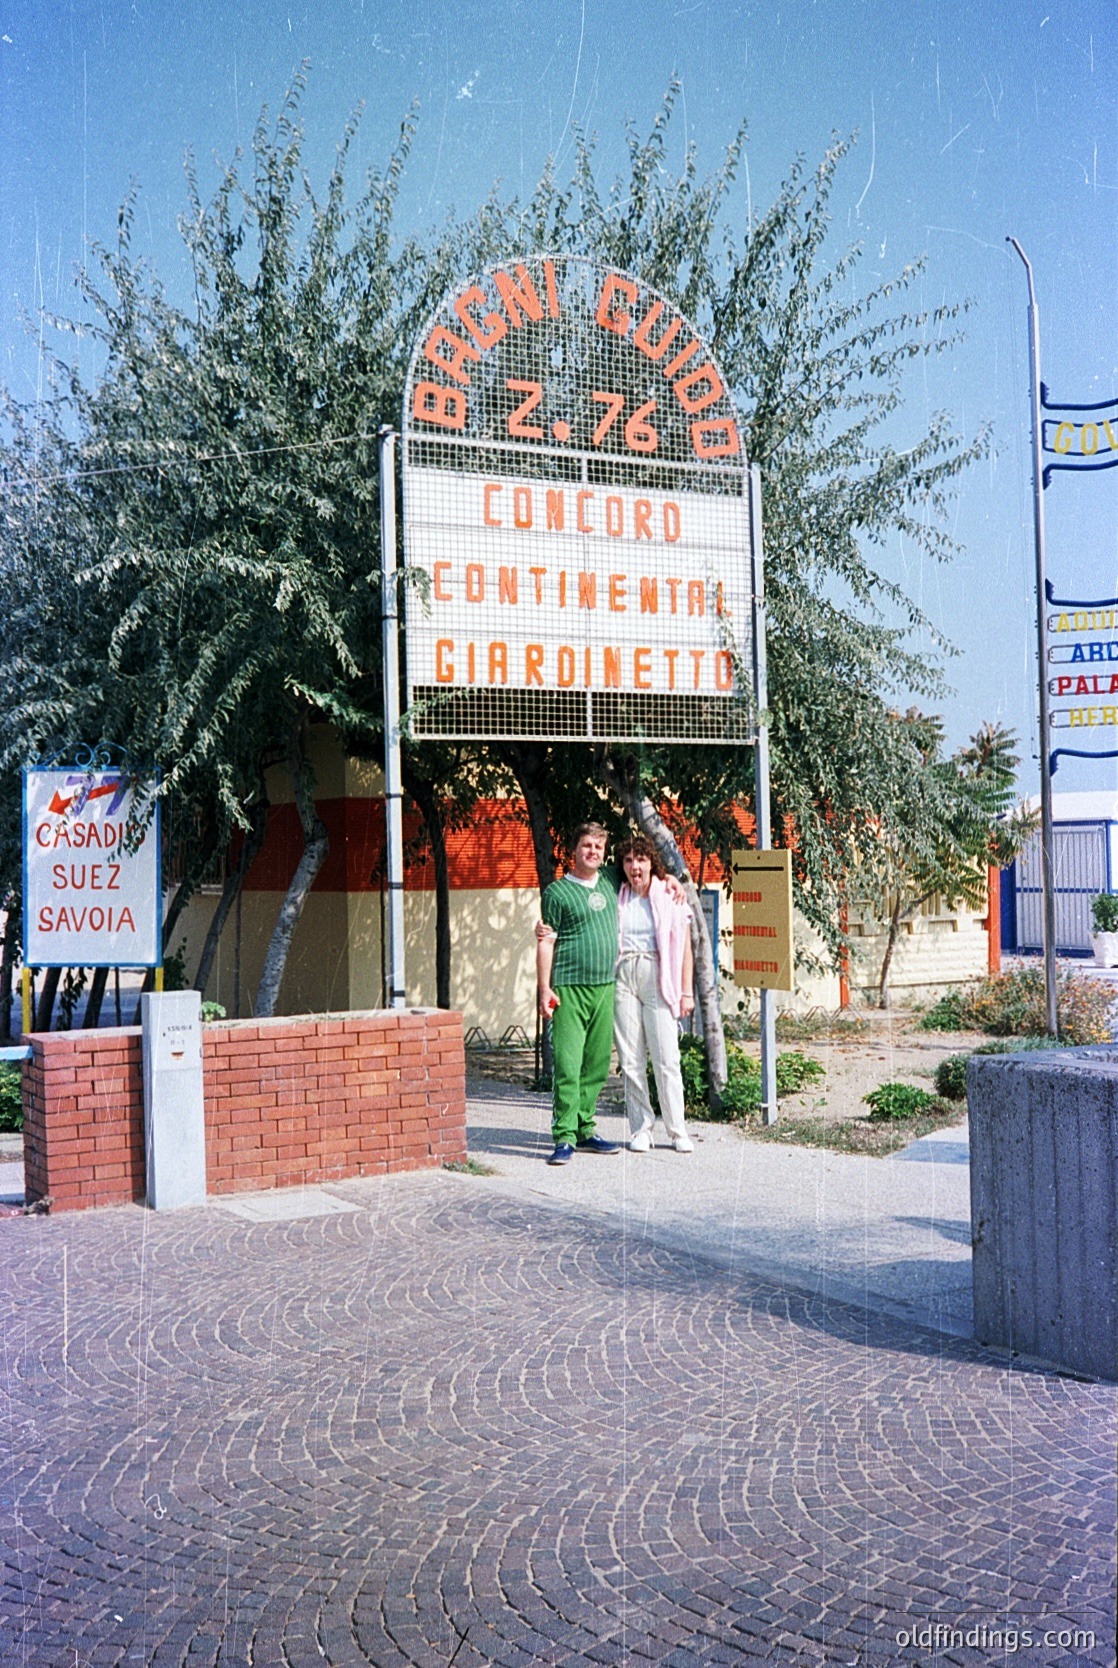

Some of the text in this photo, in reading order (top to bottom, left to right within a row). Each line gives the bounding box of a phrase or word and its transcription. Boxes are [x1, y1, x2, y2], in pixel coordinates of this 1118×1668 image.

[413, 261, 741, 459] BAGNI GUIDO
[592, 390, 659, 452] 76
[484, 483, 680, 542] CONCORD
[433, 560, 734, 617] CONTINENTAL
[436, 637, 733, 691] GIARDINETTO
[52, 864, 121, 890] SUEZ
[38, 906, 136, 933] SAVOIA
